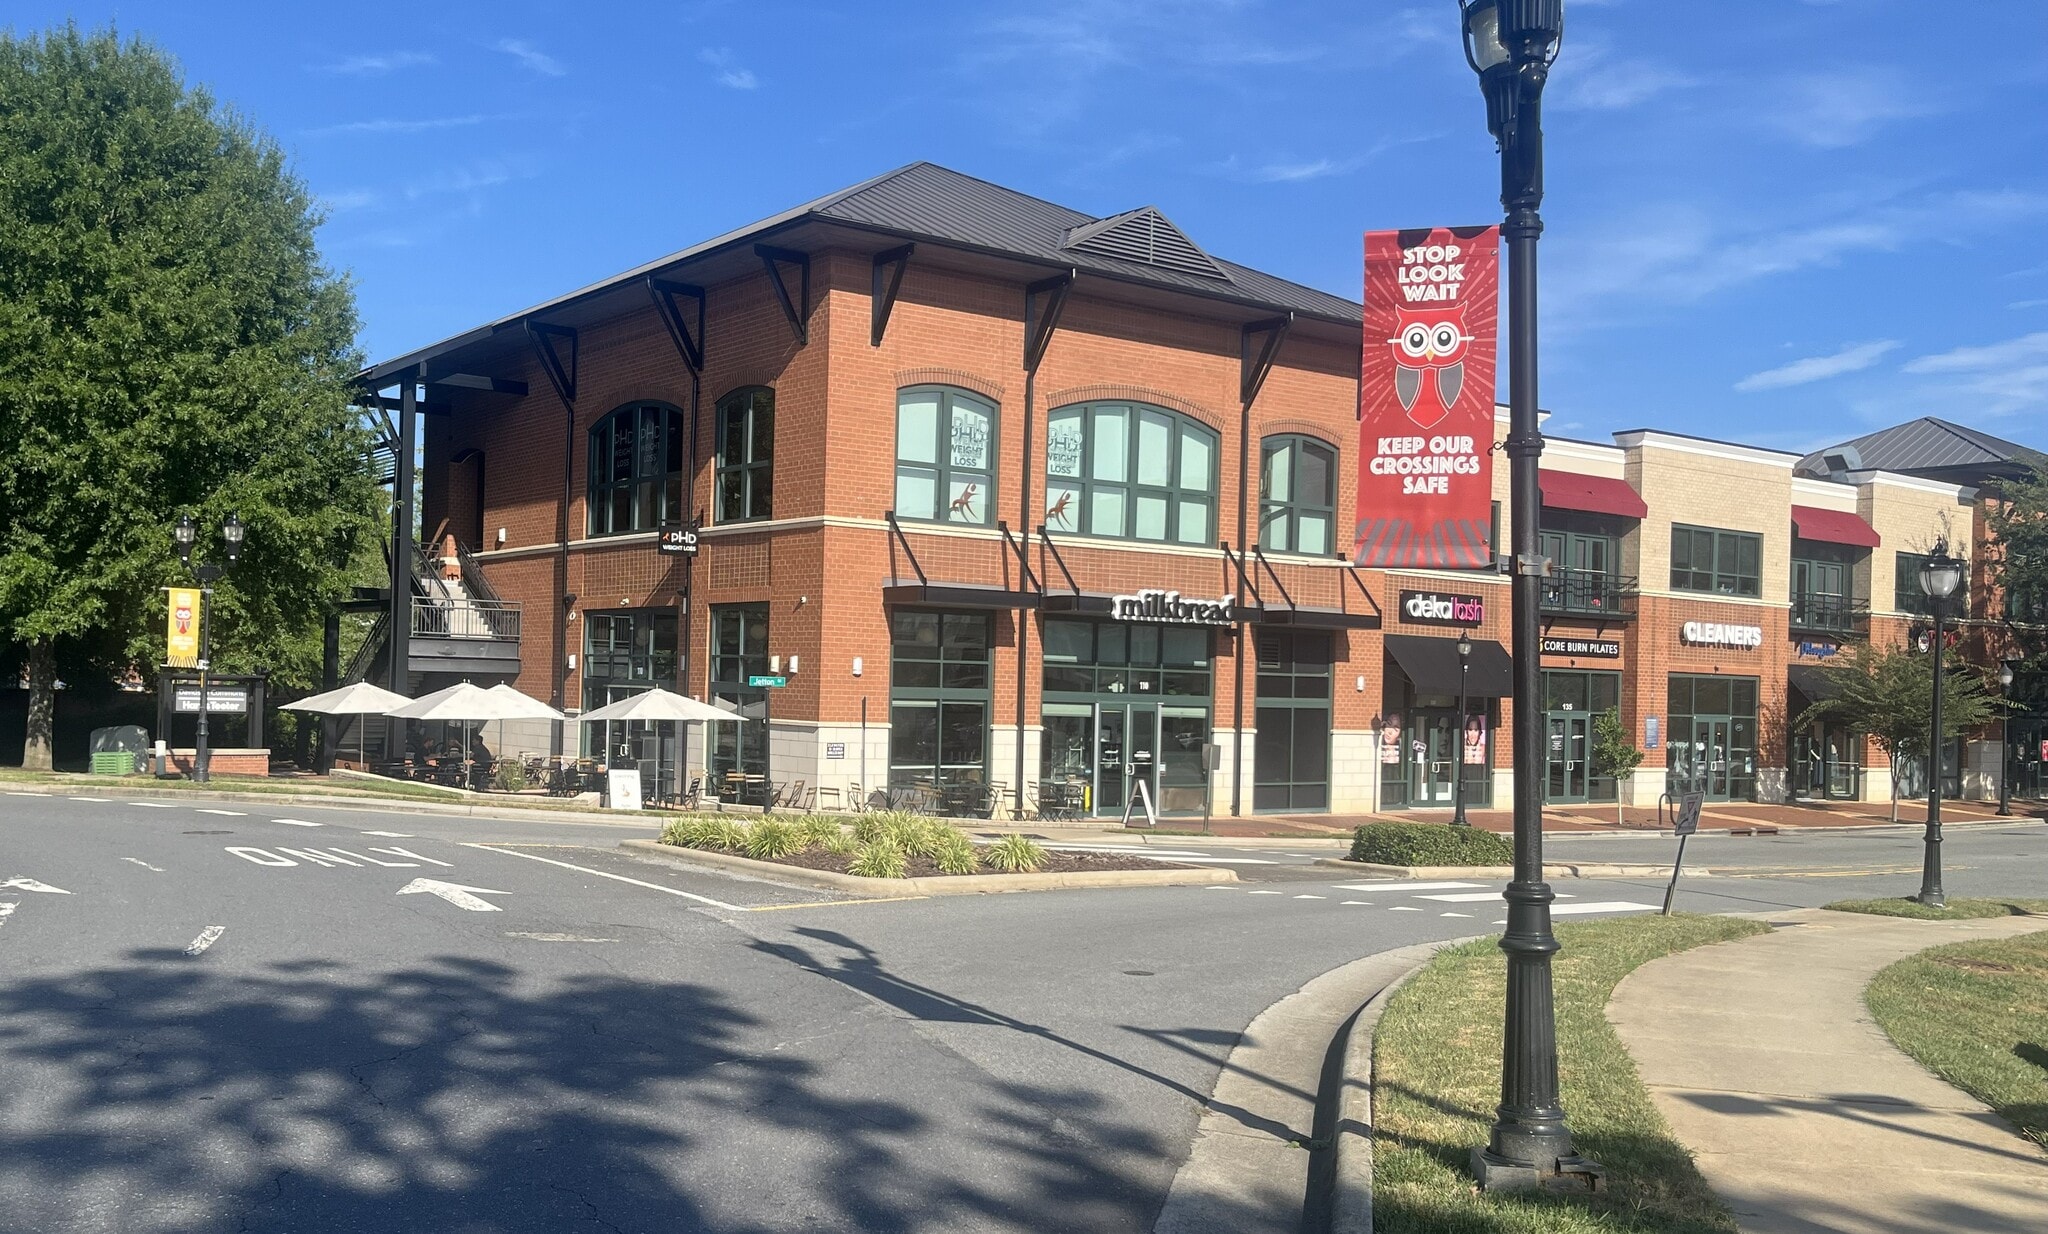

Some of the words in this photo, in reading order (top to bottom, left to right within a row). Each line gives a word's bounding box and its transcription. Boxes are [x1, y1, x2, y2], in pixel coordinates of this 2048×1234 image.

[1403, 245, 1461, 265] STOP
[1398, 264, 1465, 284] LOOK
[1402, 283, 1460, 302] WAIT
[1378, 437, 1425, 455] KEEP
[1429, 436, 1474, 454] OUR
[955, 457, 977, 467] LOSS
[1051, 465, 1071, 474] LOSS
[1370, 456, 1480, 475] CROSSINGS
[1403, 476, 1448, 495] SAFE
[1111, 589, 1236, 625] milkbread
[1684, 622, 1762, 647] CLEANERS
[1544, 641, 1566, 652] CORE
[1567, 642, 1588, 653] BURN
[1589, 644, 1618, 655] PILATES
[754, 678, 775, 687] Jetton
[1139, 681, 1149, 690] 110
[1562, 703, 1573, 711] 135
[224, 847, 455, 867] ONLY
